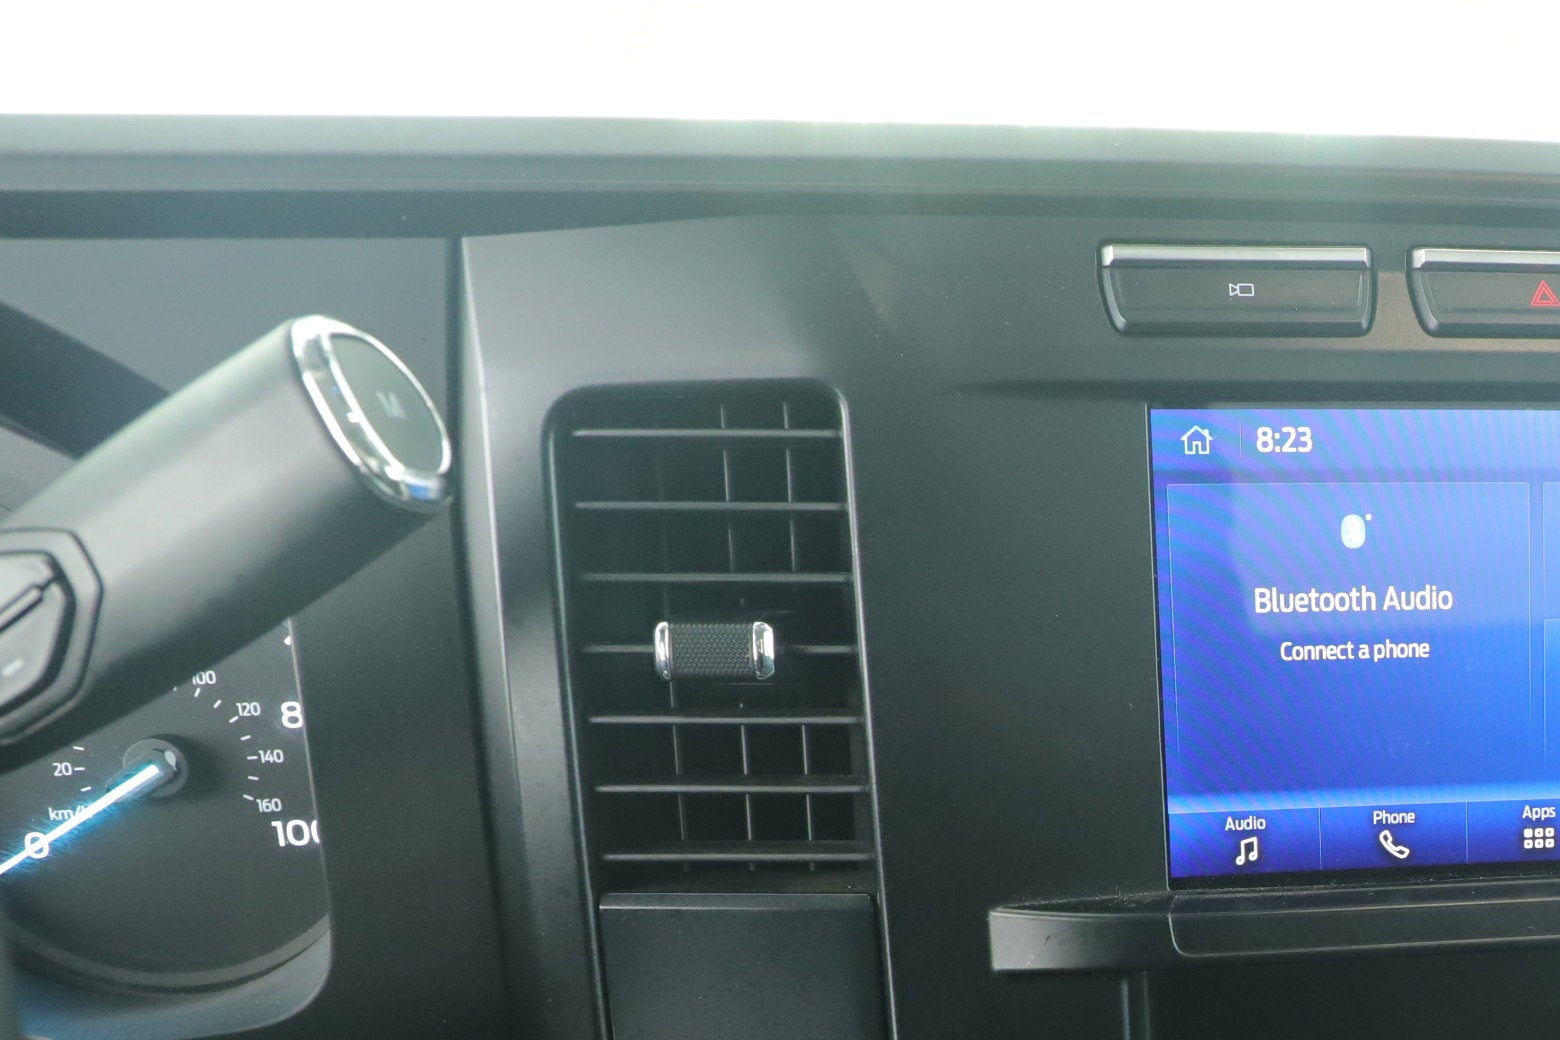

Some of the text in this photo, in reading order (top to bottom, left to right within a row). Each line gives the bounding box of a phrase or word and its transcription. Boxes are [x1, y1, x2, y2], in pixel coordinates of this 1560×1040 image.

[1256, 426, 1313, 453] 8:23
[1254, 583, 1454, 614] Bluetooth Audio
[1280, 638, 1430, 663] Connect a phone
[192, 670, 217, 685] 100
[236, 702, 261, 717] 120
[258, 749, 285, 764] 140
[52, 762, 73, 777] 20
[255, 797, 283, 813] 160
[1522, 804, 1556, 821] Apps
[1224, 815, 1267, 831] Audio
[1373, 809, 1416, 825] Phone
